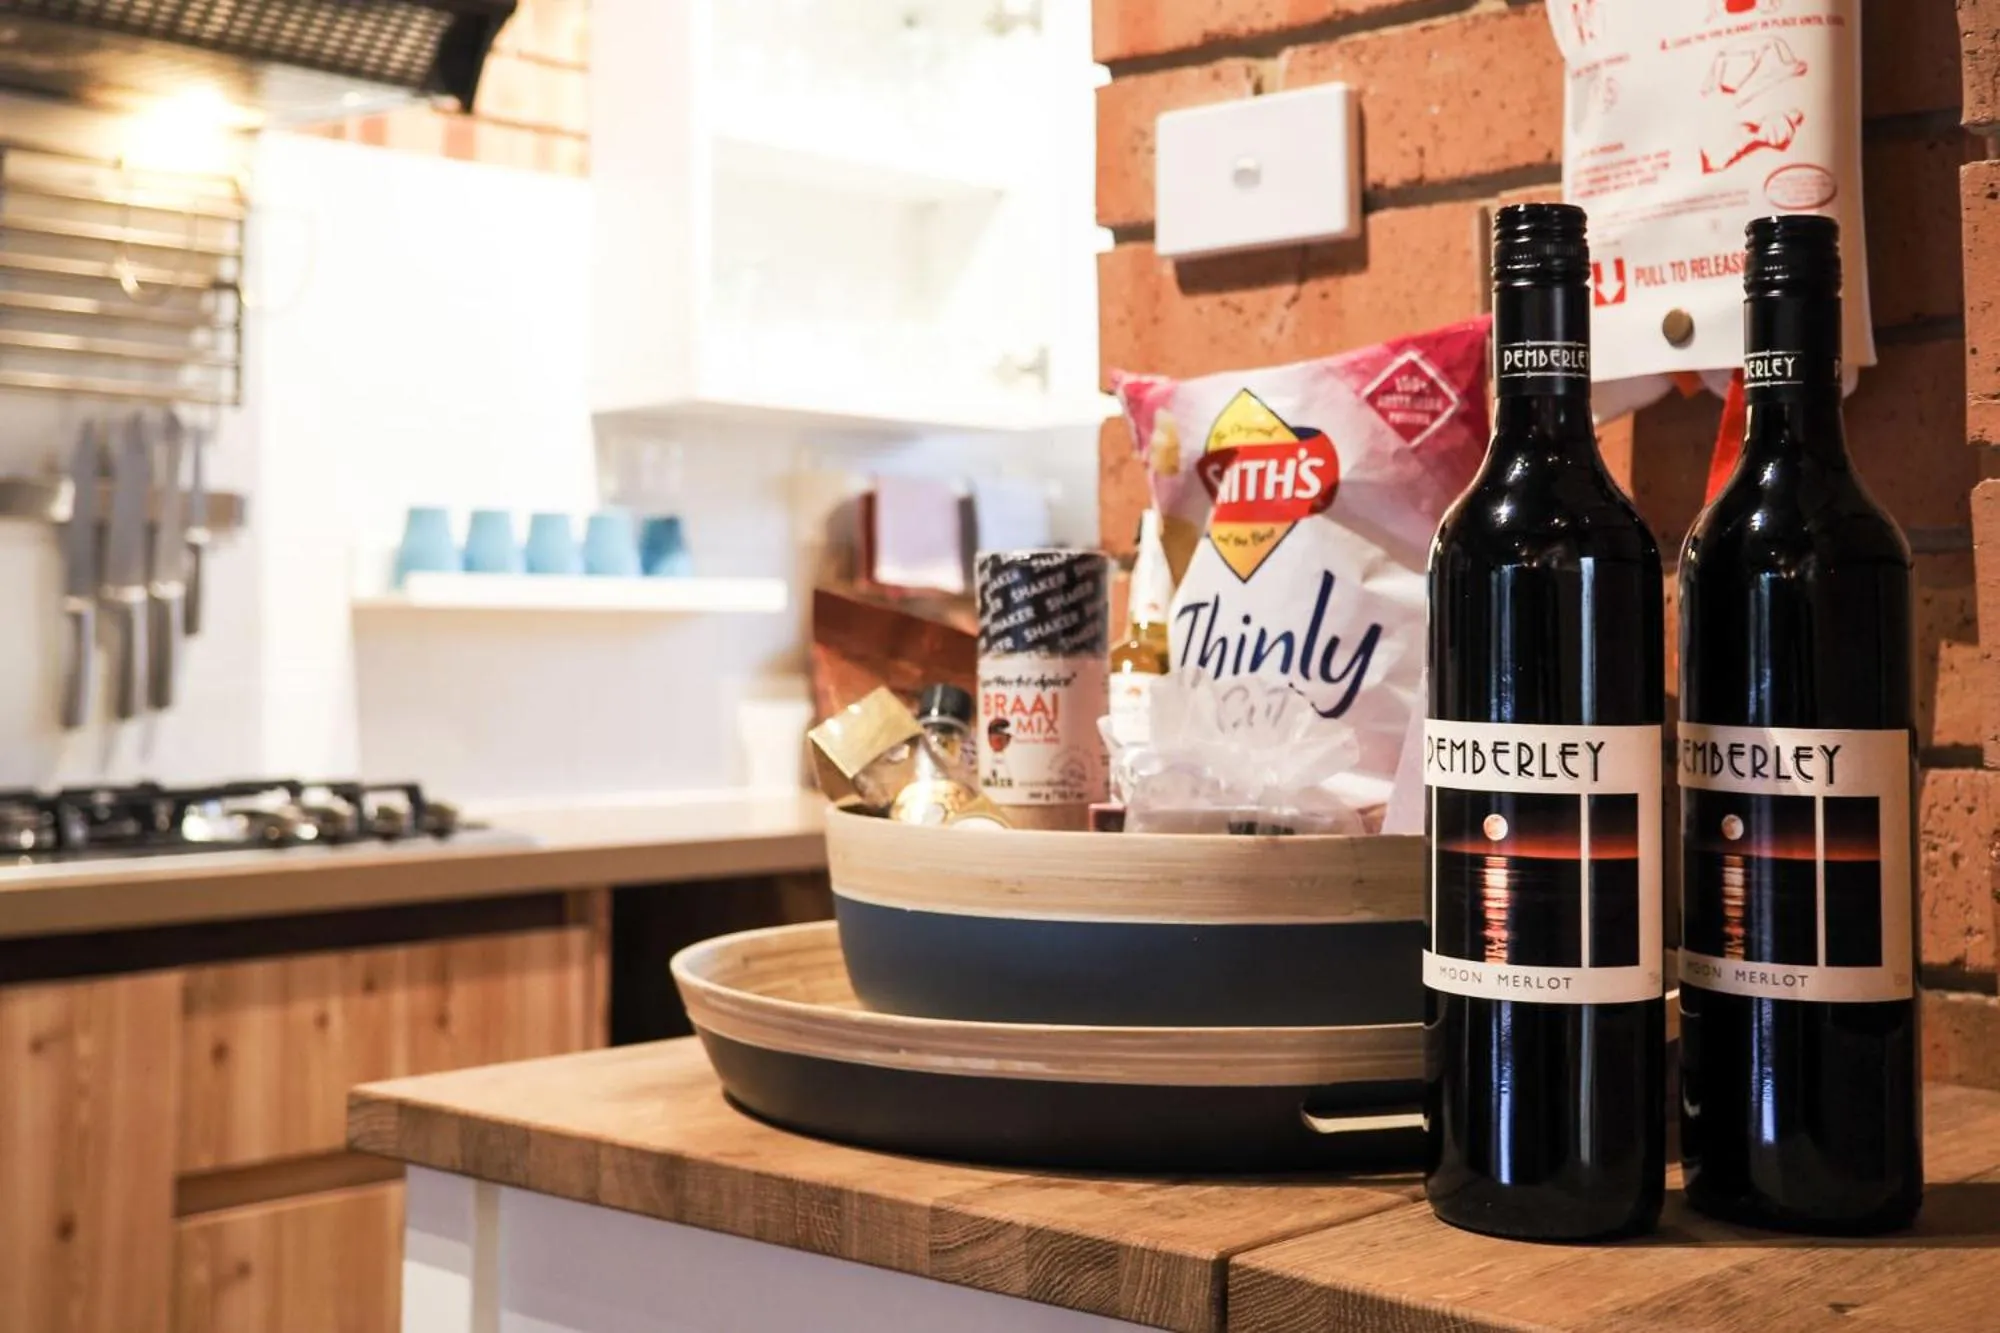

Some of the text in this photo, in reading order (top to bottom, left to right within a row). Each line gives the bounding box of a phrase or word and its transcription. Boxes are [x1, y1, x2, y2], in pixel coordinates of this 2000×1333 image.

[1634, 264, 1666, 288] PULL
[1669, 260, 1687, 282] TO
[1010, 571, 1067, 603] SHAKER
[1175, 568, 1383, 720] Thinly
[1016, 716, 1059, 734] MIX
[1439, 965, 1573, 990] MOON MERLOT
[1735, 969, 1809, 988] MERLOT
